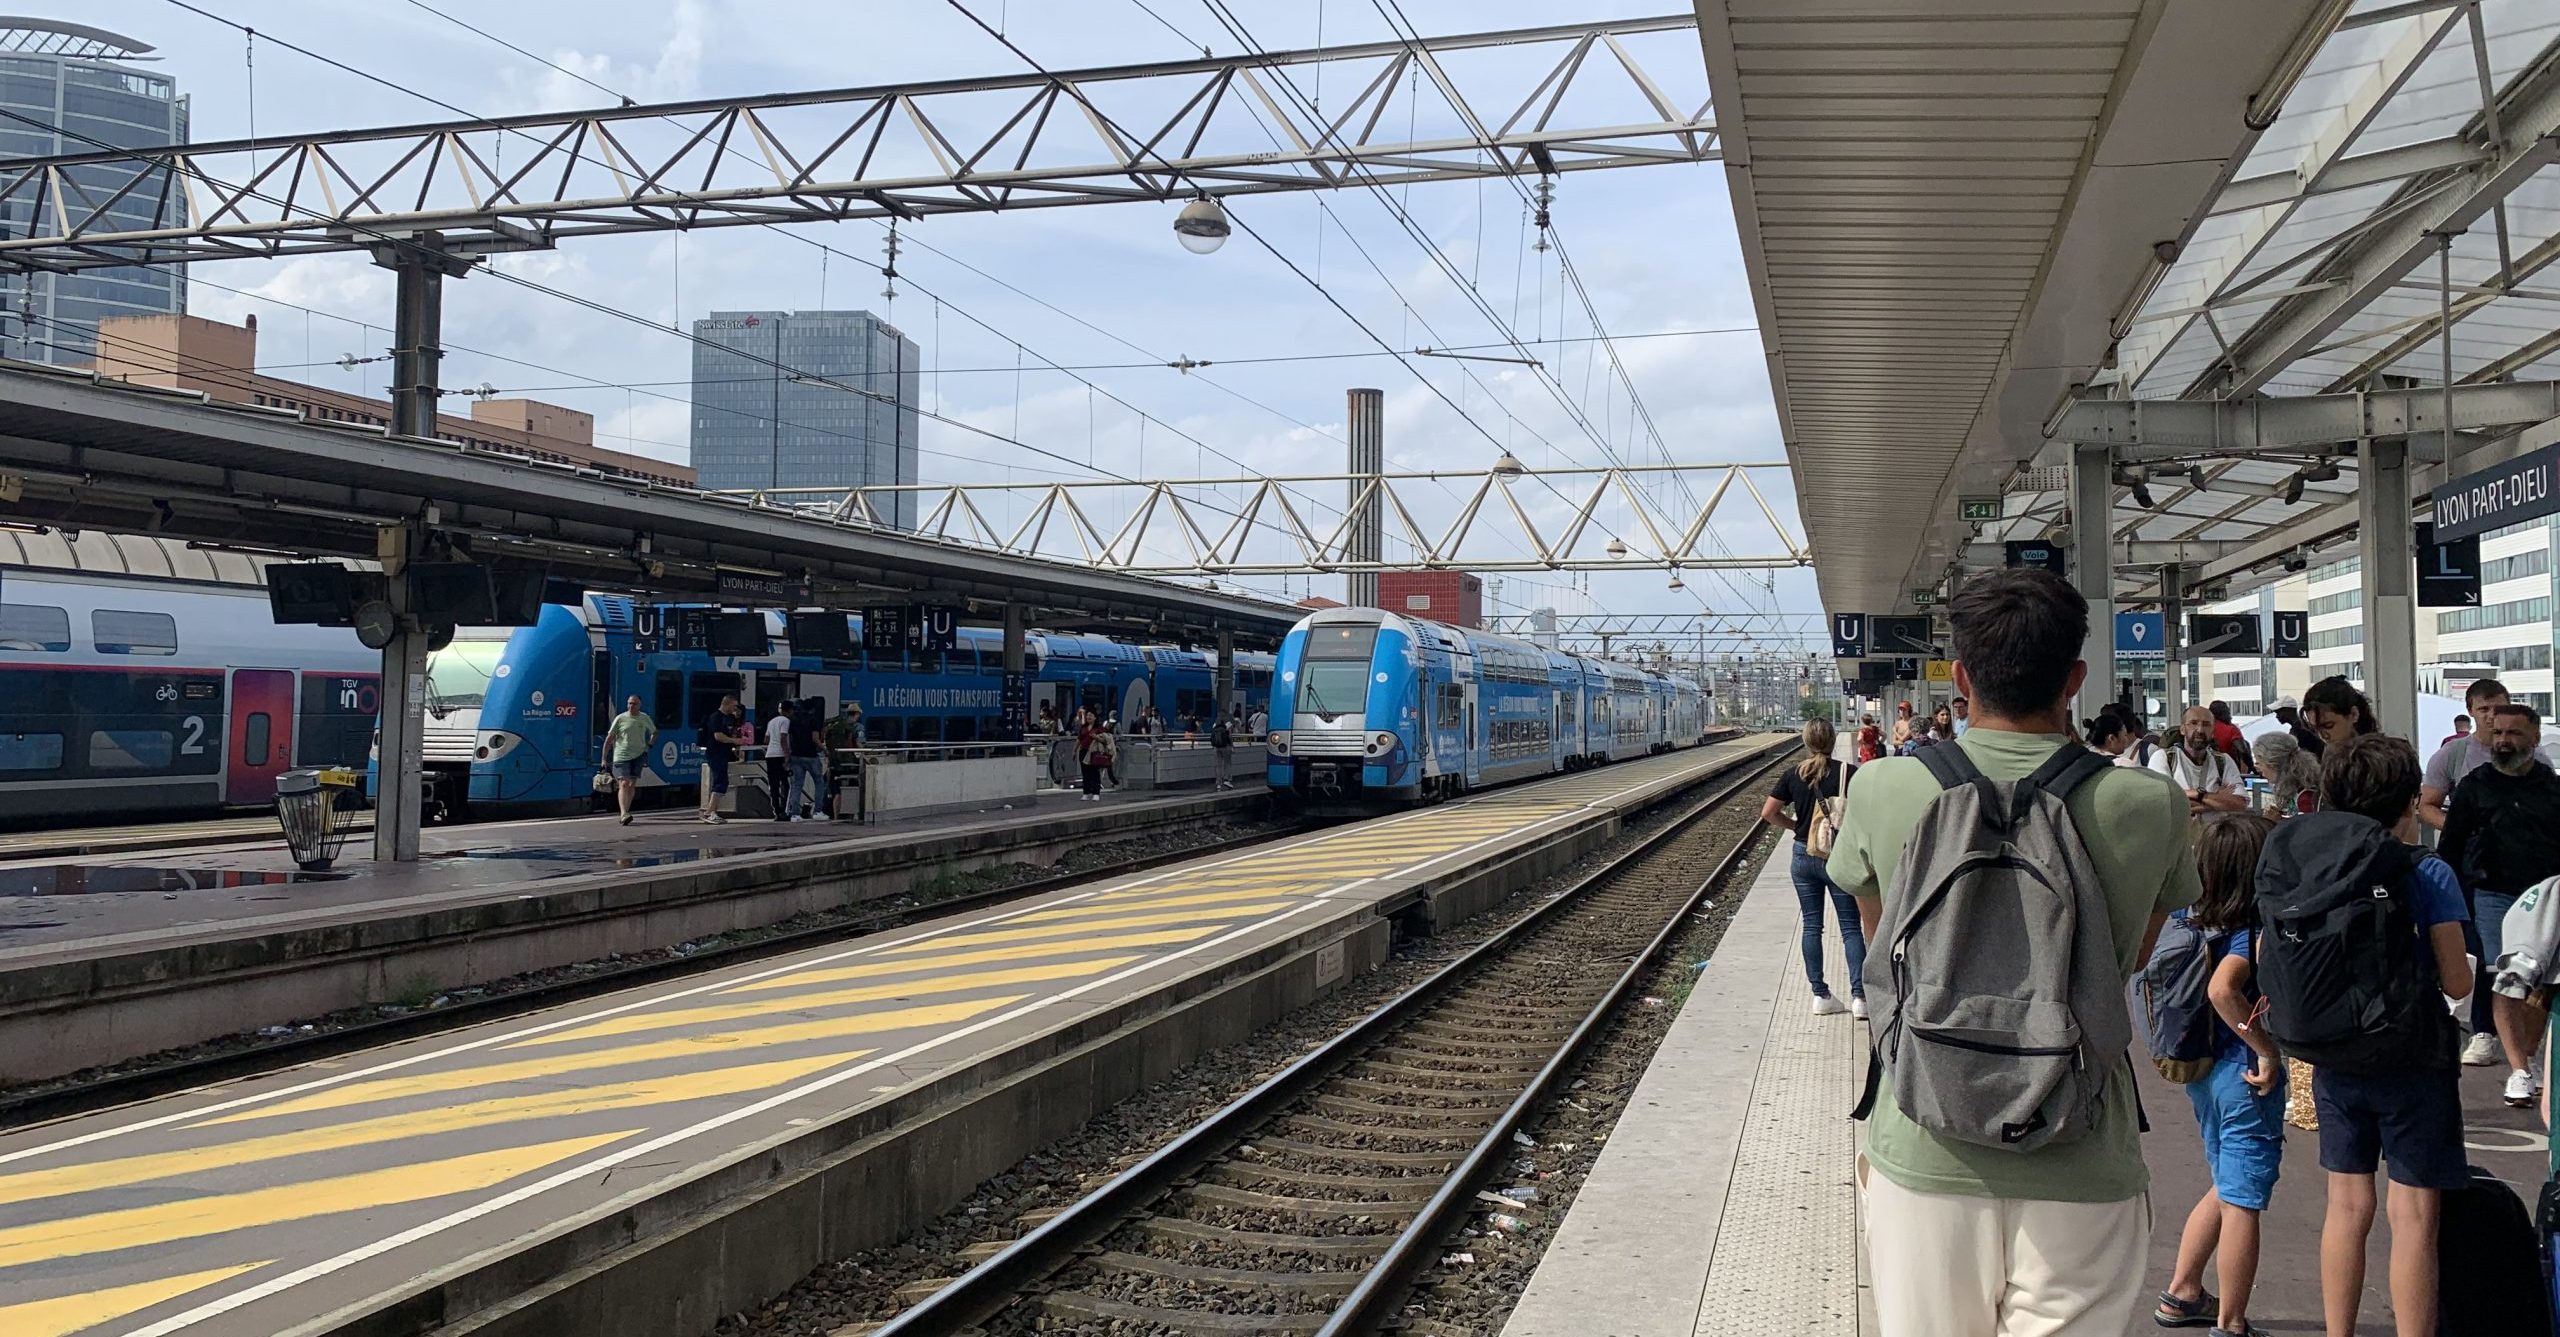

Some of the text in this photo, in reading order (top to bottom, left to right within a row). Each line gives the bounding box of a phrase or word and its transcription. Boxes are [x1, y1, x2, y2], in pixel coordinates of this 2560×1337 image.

[2437, 464, 2548, 529] LYON PART-DIEU
[2439, 545, 2462, 574] L
[722, 576, 743, 590] LYON
[745, 578, 784, 594] PART-DIEU
[639, 614, 653, 636] U
[934, 612, 950, 634] U
[1840, 619, 1858, 641] U
[2281, 619, 2300, 641] U
[1856, 648, 1862, 656] K
[1902, 657, 1911, 668] K
[342, 679, 358, 688] TGV
[873, 683, 1001, 708] LA RÉGION VOUS TRANSPORTE
[556, 706, 577, 716] SNCF
[181, 715, 204, 755] 2
